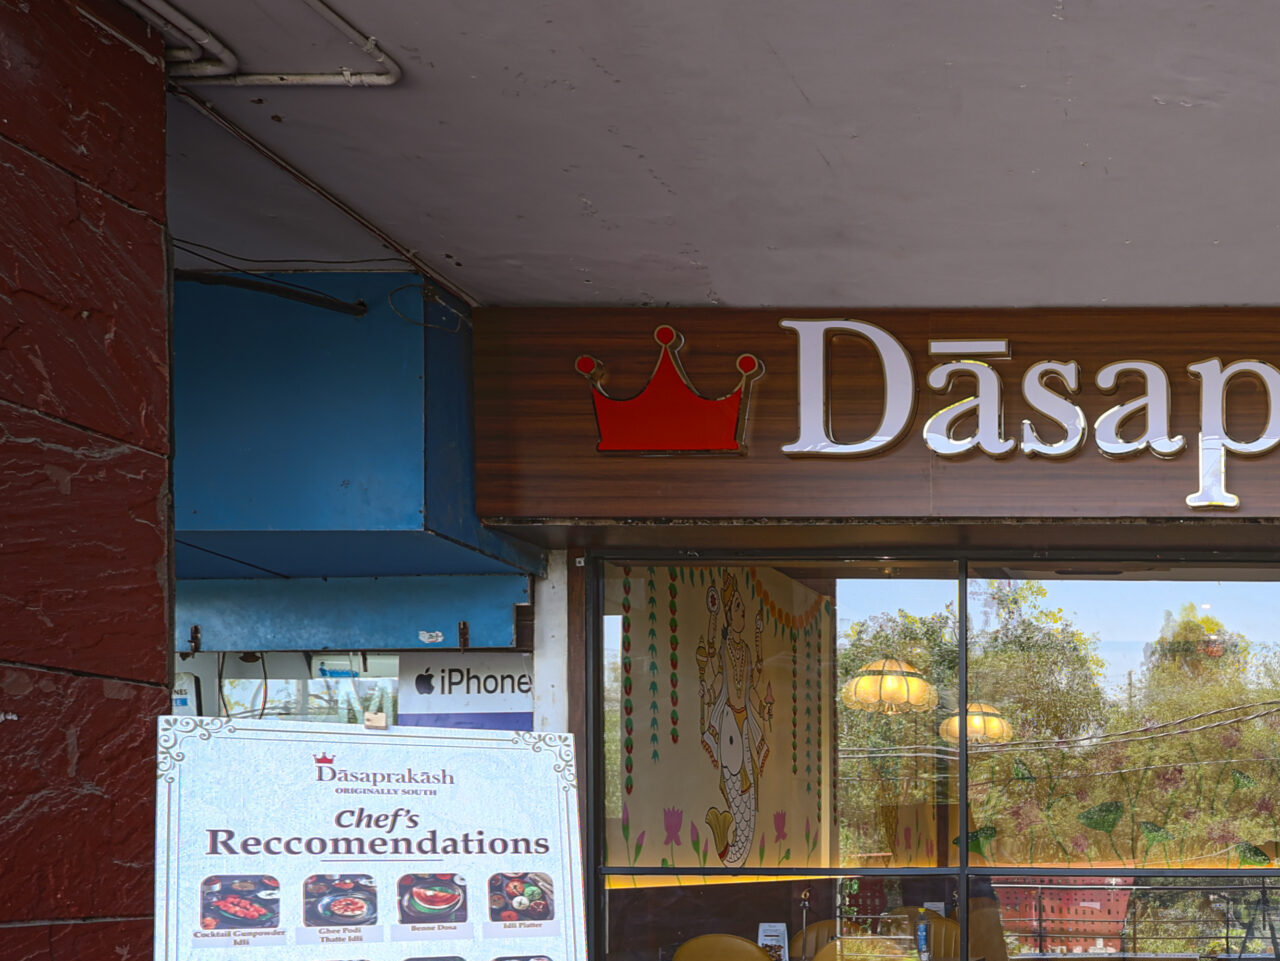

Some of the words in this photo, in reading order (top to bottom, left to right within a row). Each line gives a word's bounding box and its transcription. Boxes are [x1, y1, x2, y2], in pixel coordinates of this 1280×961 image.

[441, 668, 532, 694] iPhone
[315, 765, 454, 786] Dāsaprakāsh
[335, 807, 419, 833] Chef's
[206, 828, 549, 855] Reccomendations
